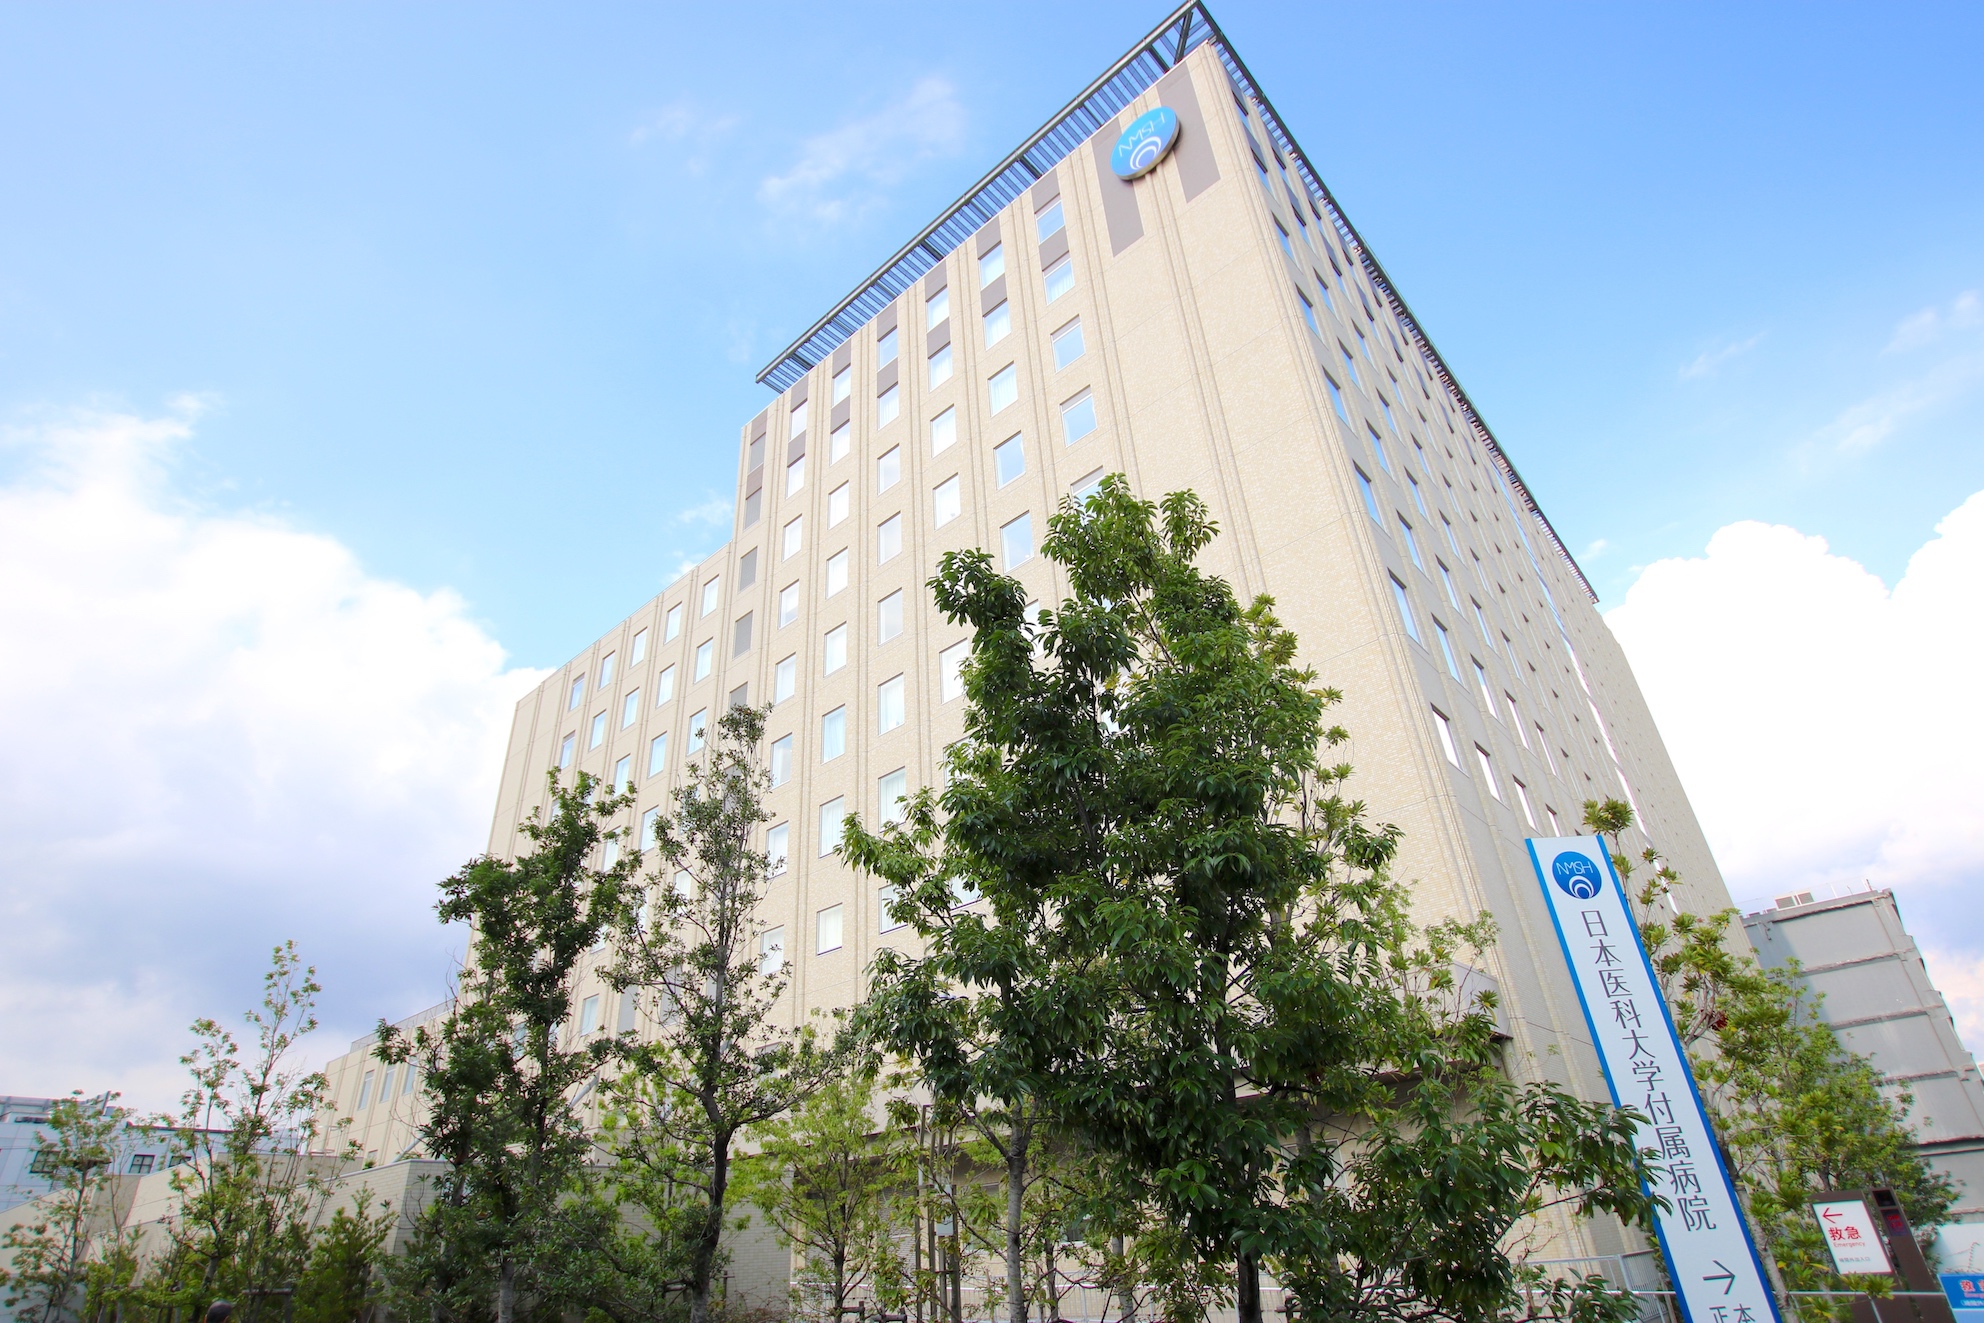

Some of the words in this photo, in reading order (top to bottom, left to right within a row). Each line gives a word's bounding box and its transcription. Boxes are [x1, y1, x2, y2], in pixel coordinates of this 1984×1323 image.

[1555, 861, 1593, 875] NMSH
[1580, 909, 1717, 1233] 日本医科大学付属病院
[1828, 1225, 1862, 1241] 救急
